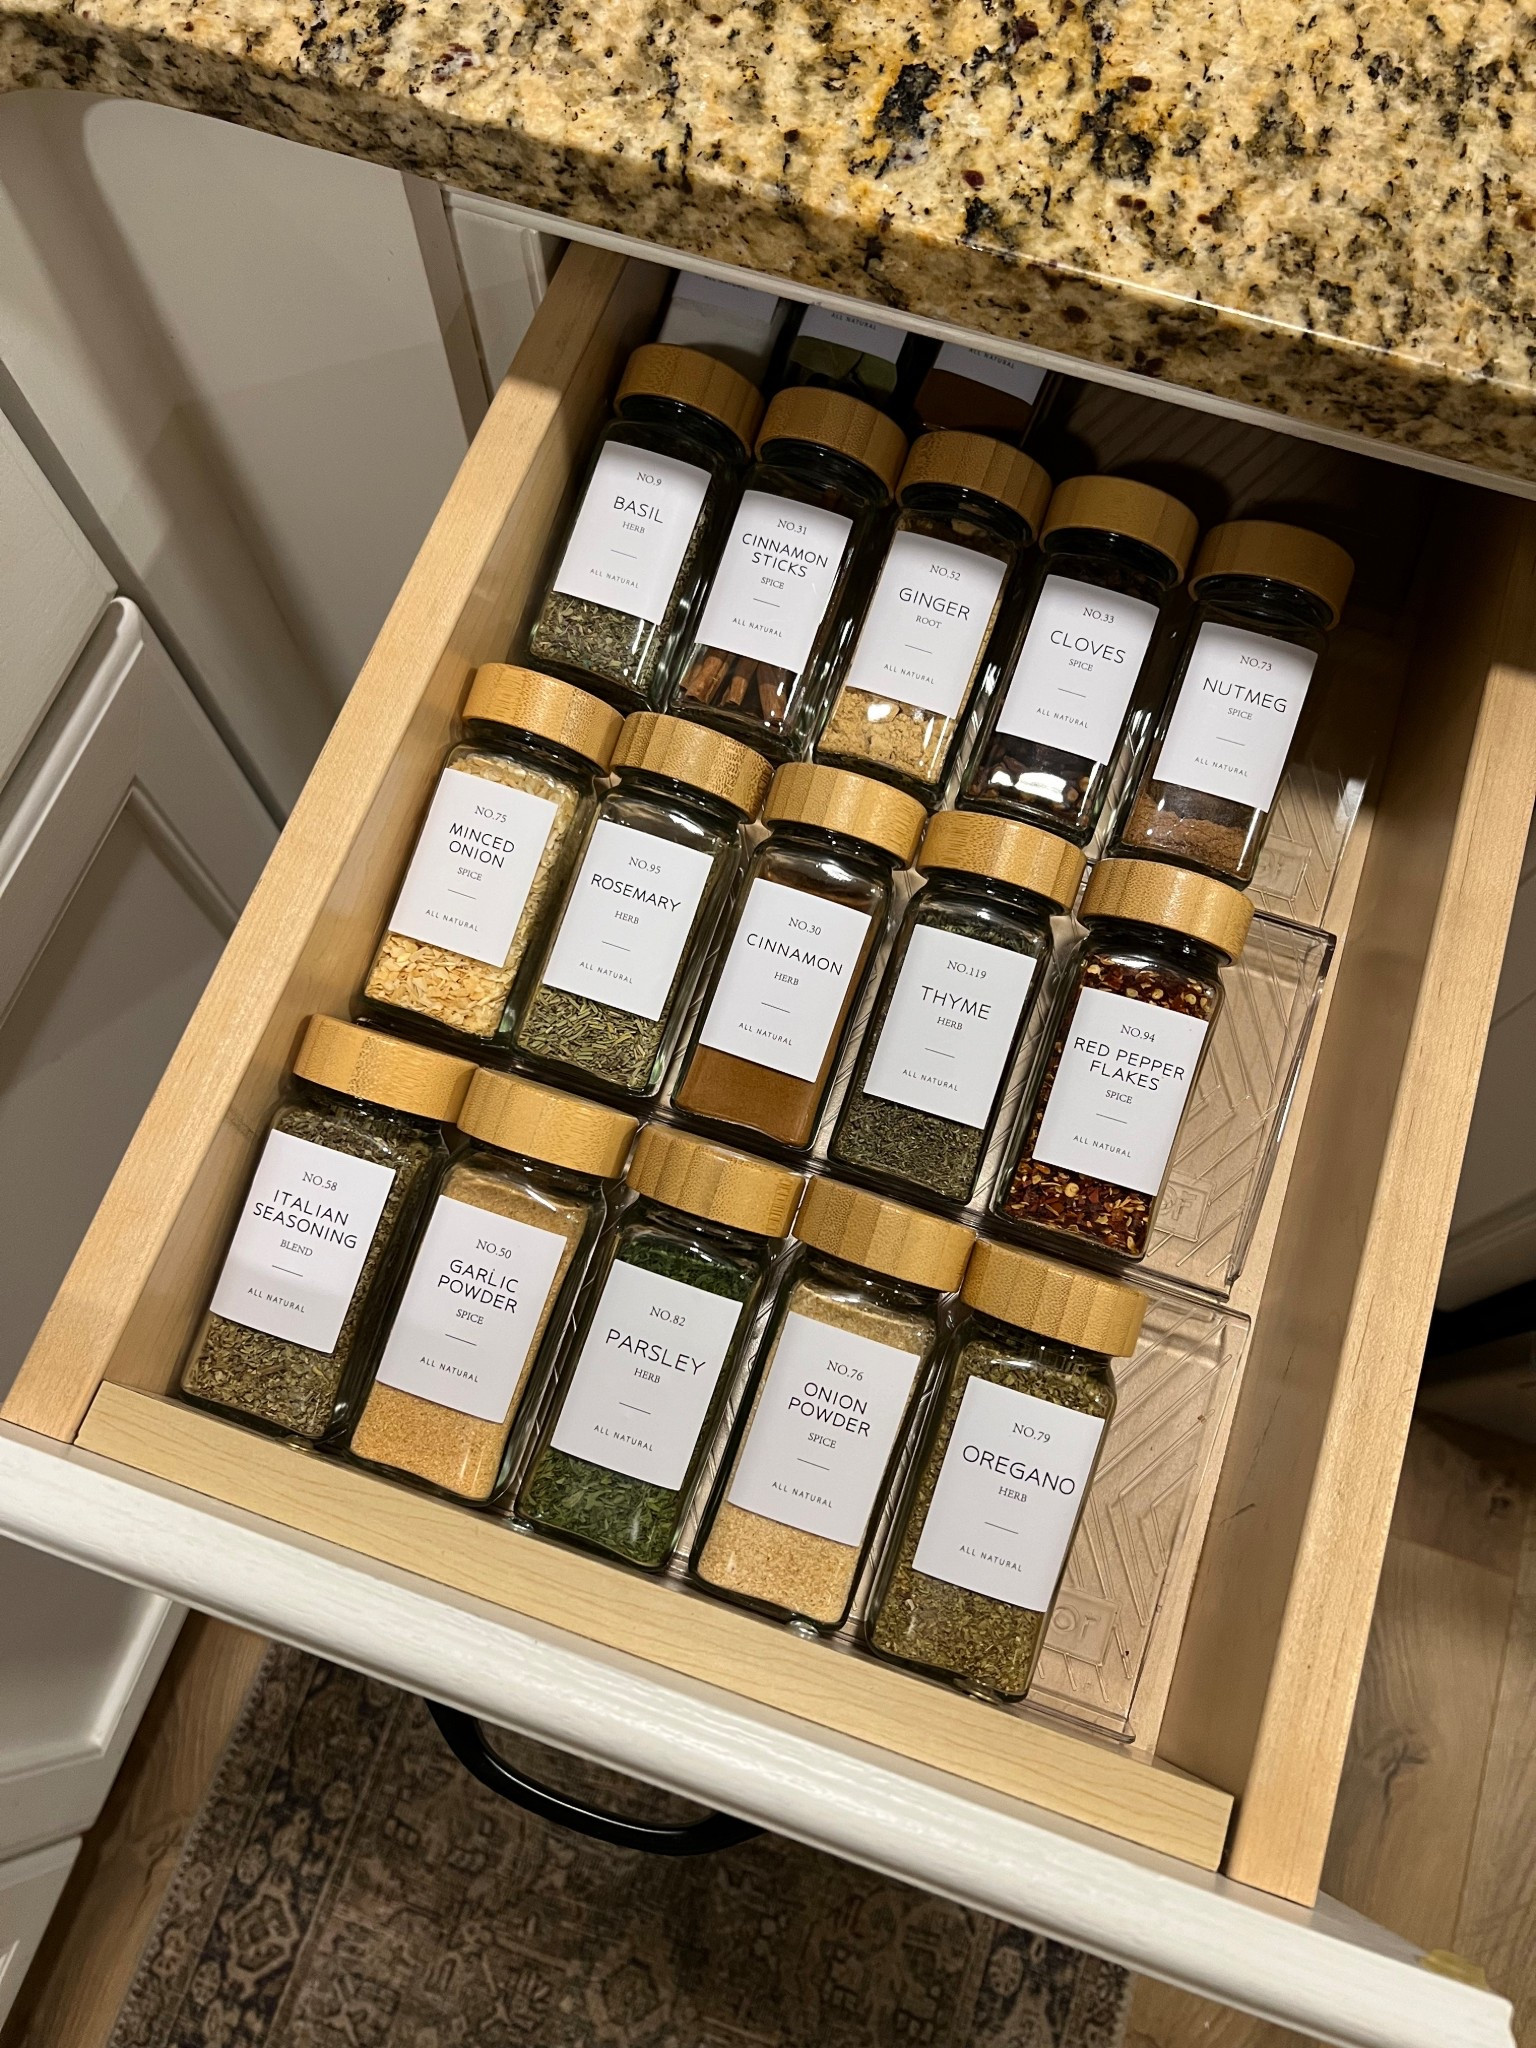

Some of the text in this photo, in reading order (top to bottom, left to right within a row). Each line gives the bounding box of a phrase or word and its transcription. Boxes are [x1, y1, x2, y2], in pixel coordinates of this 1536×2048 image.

[830, 311, 877, 331] ALL NATURAL
[983, 352, 1015, 369] NATURAL
[636, 471, 662, 486] NO.9
[612, 495, 665, 524] BASIL
[622, 520, 646, 534] HERB
[777, 518, 808, 536] NO.31
[741, 532, 829, 569] CINNAMON
[751, 551, 808, 578] STICKS
[929, 564, 961, 582] NO.52
[590, 568, 639, 589] ALL NATURAL
[760, 576, 785, 590] SPICE
[898, 587, 972, 621] GINGER
[915, 615, 942, 629] ROOT
[1082, 607, 1115, 624] NO.33
[732, 617, 782, 638] ALL NATURAL
[1049, 630, 1127, 665] CLOVES
[883, 663, 934, 685] ALL NATURAL
[1068, 658, 1094, 672] SPICE
[1239, 655, 1273, 672] NO.73
[1202, 677, 1288, 713] NUTMEG
[1036, 707, 1088, 729] ALL NATURAL
[1227, 707, 1253, 721] SPICE
[1194, 757, 1248, 777] ALL NATURAL
[474, 805, 508, 823] NO.75
[448, 823, 516, 853] MINCED
[448, 840, 505, 869] ONION
[628, 856, 662, 875] NO.95
[457, 866, 483, 882] SPICE
[590, 873, 682, 913] ROSEMARY
[425, 909, 478, 932] ALL NATURAL
[614, 910, 640, 925] HERB
[788, 916, 822, 936] NO.30
[746, 933, 843, 976] CINNAMON
[579, 961, 633, 984] ALL NATURAL
[773, 971, 800, 986] HERB
[946, 959, 987, 980] NO.119
[921, 985, 993, 1020] THYME
[738, 1022, 792, 1046] ALL NATURAL
[936, 1016, 963, 1031] HERB
[1120, 1024, 1156, 1043] NO.94
[1073, 1037, 1185, 1081] RED PEPPER
[902, 1069, 958, 1092] ALL NATURAL
[1089, 1059, 1162, 1092] FLAKES
[1105, 1089, 1133, 1105] SPICE
[1072, 1135, 1131, 1158] ALL NATURAL
[301, 1171, 338, 1192] NO.58
[273, 1189, 350, 1227] ITALIAN
[252, 1202, 358, 1249] SEASONING
[279, 1239, 313, 1257] BLEND
[475, 1238, 512, 1260] NO.50
[448, 1259, 520, 1294] GARLIC
[247, 1287, 306, 1314] ALL NATURAL
[437, 1274, 518, 1314] POWDER
[455, 1308, 485, 1325] SPICE
[649, 1305, 686, 1327] NO.82
[605, 1328, 707, 1377] PARSLEY
[419, 1356, 479, 1383] ALL NATURAL
[633, 1367, 662, 1384] HERB
[826, 1359, 864, 1382] NO.76
[803, 1381, 868, 1415] ONION
[787, 1397, 872, 1437] POWDER
[593, 1424, 654, 1452] ALL NATURAL
[807, 1432, 837, 1449] SPICE
[1012, 1422, 1051, 1444] NO.79
[961, 1445, 1077, 1496] OREGANO
[771, 1481, 833, 1508] ALL NATURAL
[998, 1485, 1028, 1503] HERB
[959, 1545, 1022, 1572] ALL NATURAL
